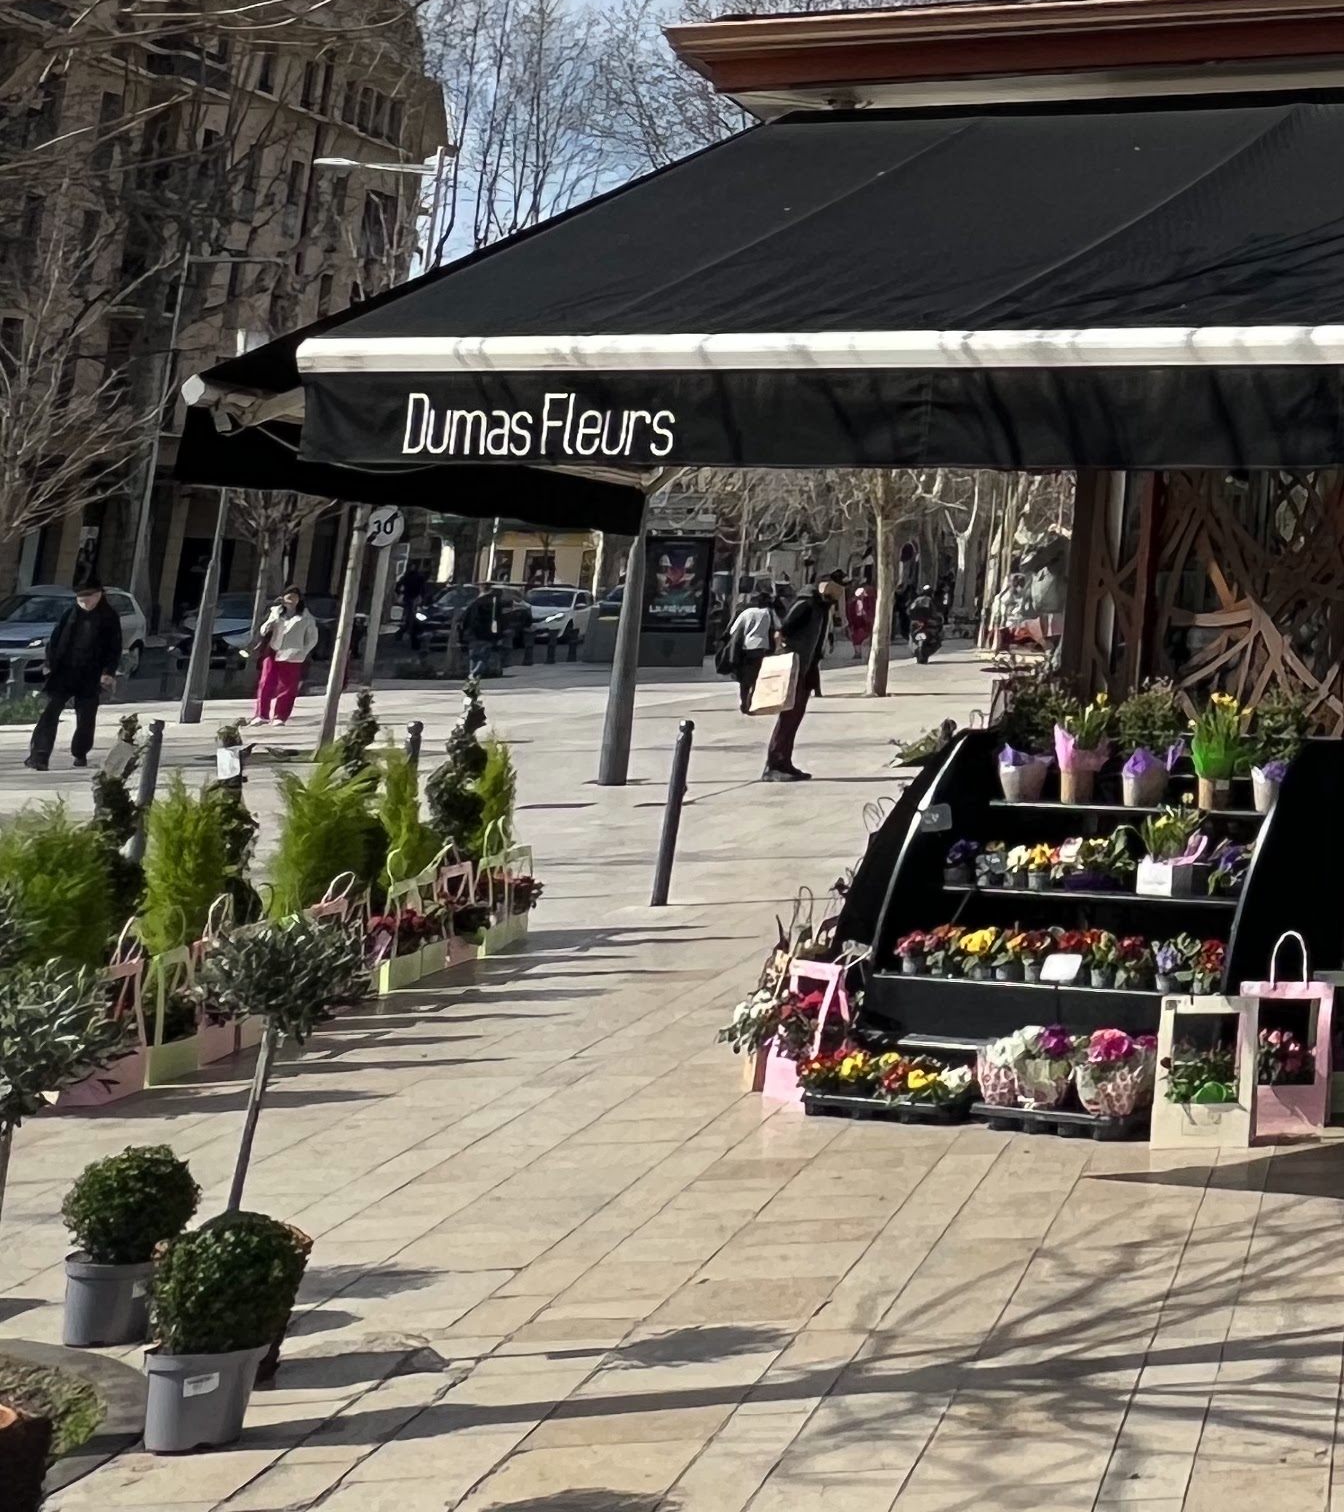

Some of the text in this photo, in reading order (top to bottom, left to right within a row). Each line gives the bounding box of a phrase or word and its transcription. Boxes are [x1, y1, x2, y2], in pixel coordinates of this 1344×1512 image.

[401, 392, 676, 457] Dumas Fleurs
[373, 519, 394, 535] 30
